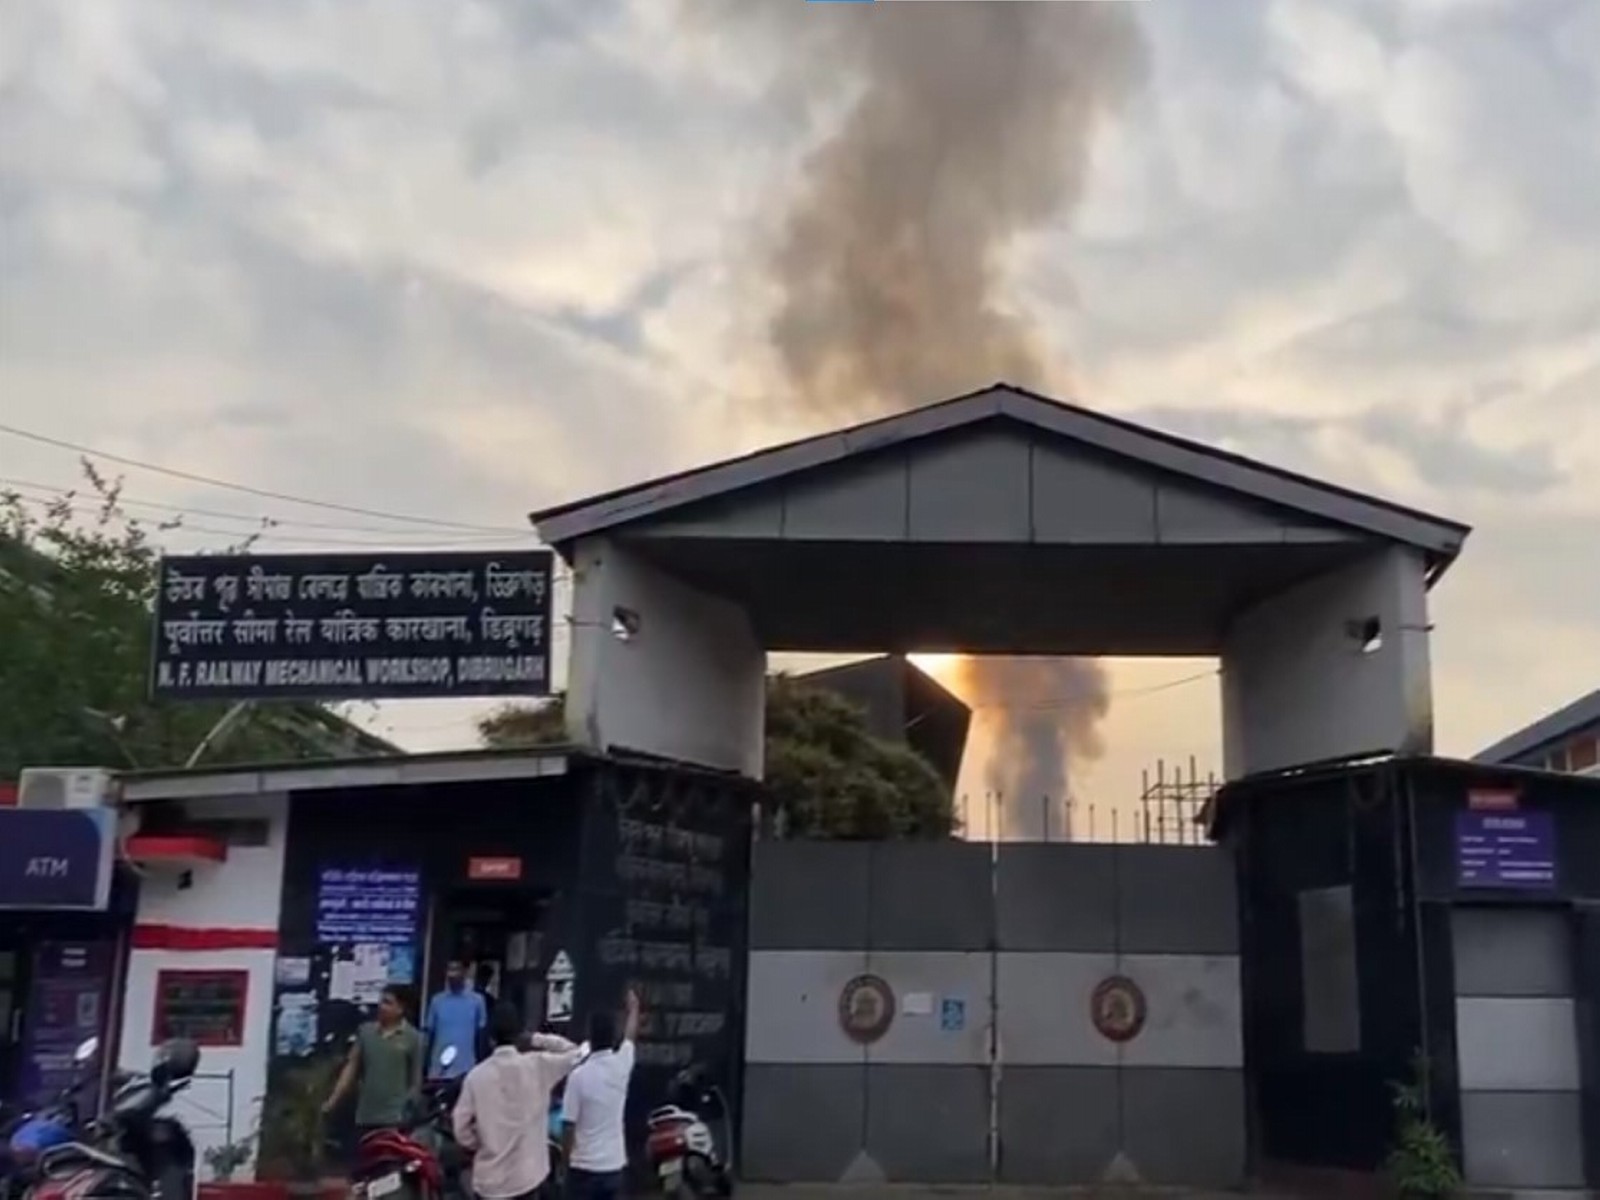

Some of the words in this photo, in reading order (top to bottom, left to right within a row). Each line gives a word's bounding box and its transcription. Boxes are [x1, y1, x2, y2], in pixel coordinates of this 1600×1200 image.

[163, 610, 227, 654] पूर्वोत्तर
[232, 609, 279, 644] सीमा
[284, 609, 314, 643] रेल
[319, 609, 381, 643] यांत्रिक
[385, 615, 472, 645] कारखाना,
[158, 661, 174, 686] N.
[179, 661, 191, 686] F.
[195, 660, 262, 686] RAILWAY
[265, 659, 363, 686] MECHANICAL
[366, 656, 453, 688] WORKSHOP,
[457, 655, 545, 683] DIBRUGARH
[25, 857, 69, 877] ATM
